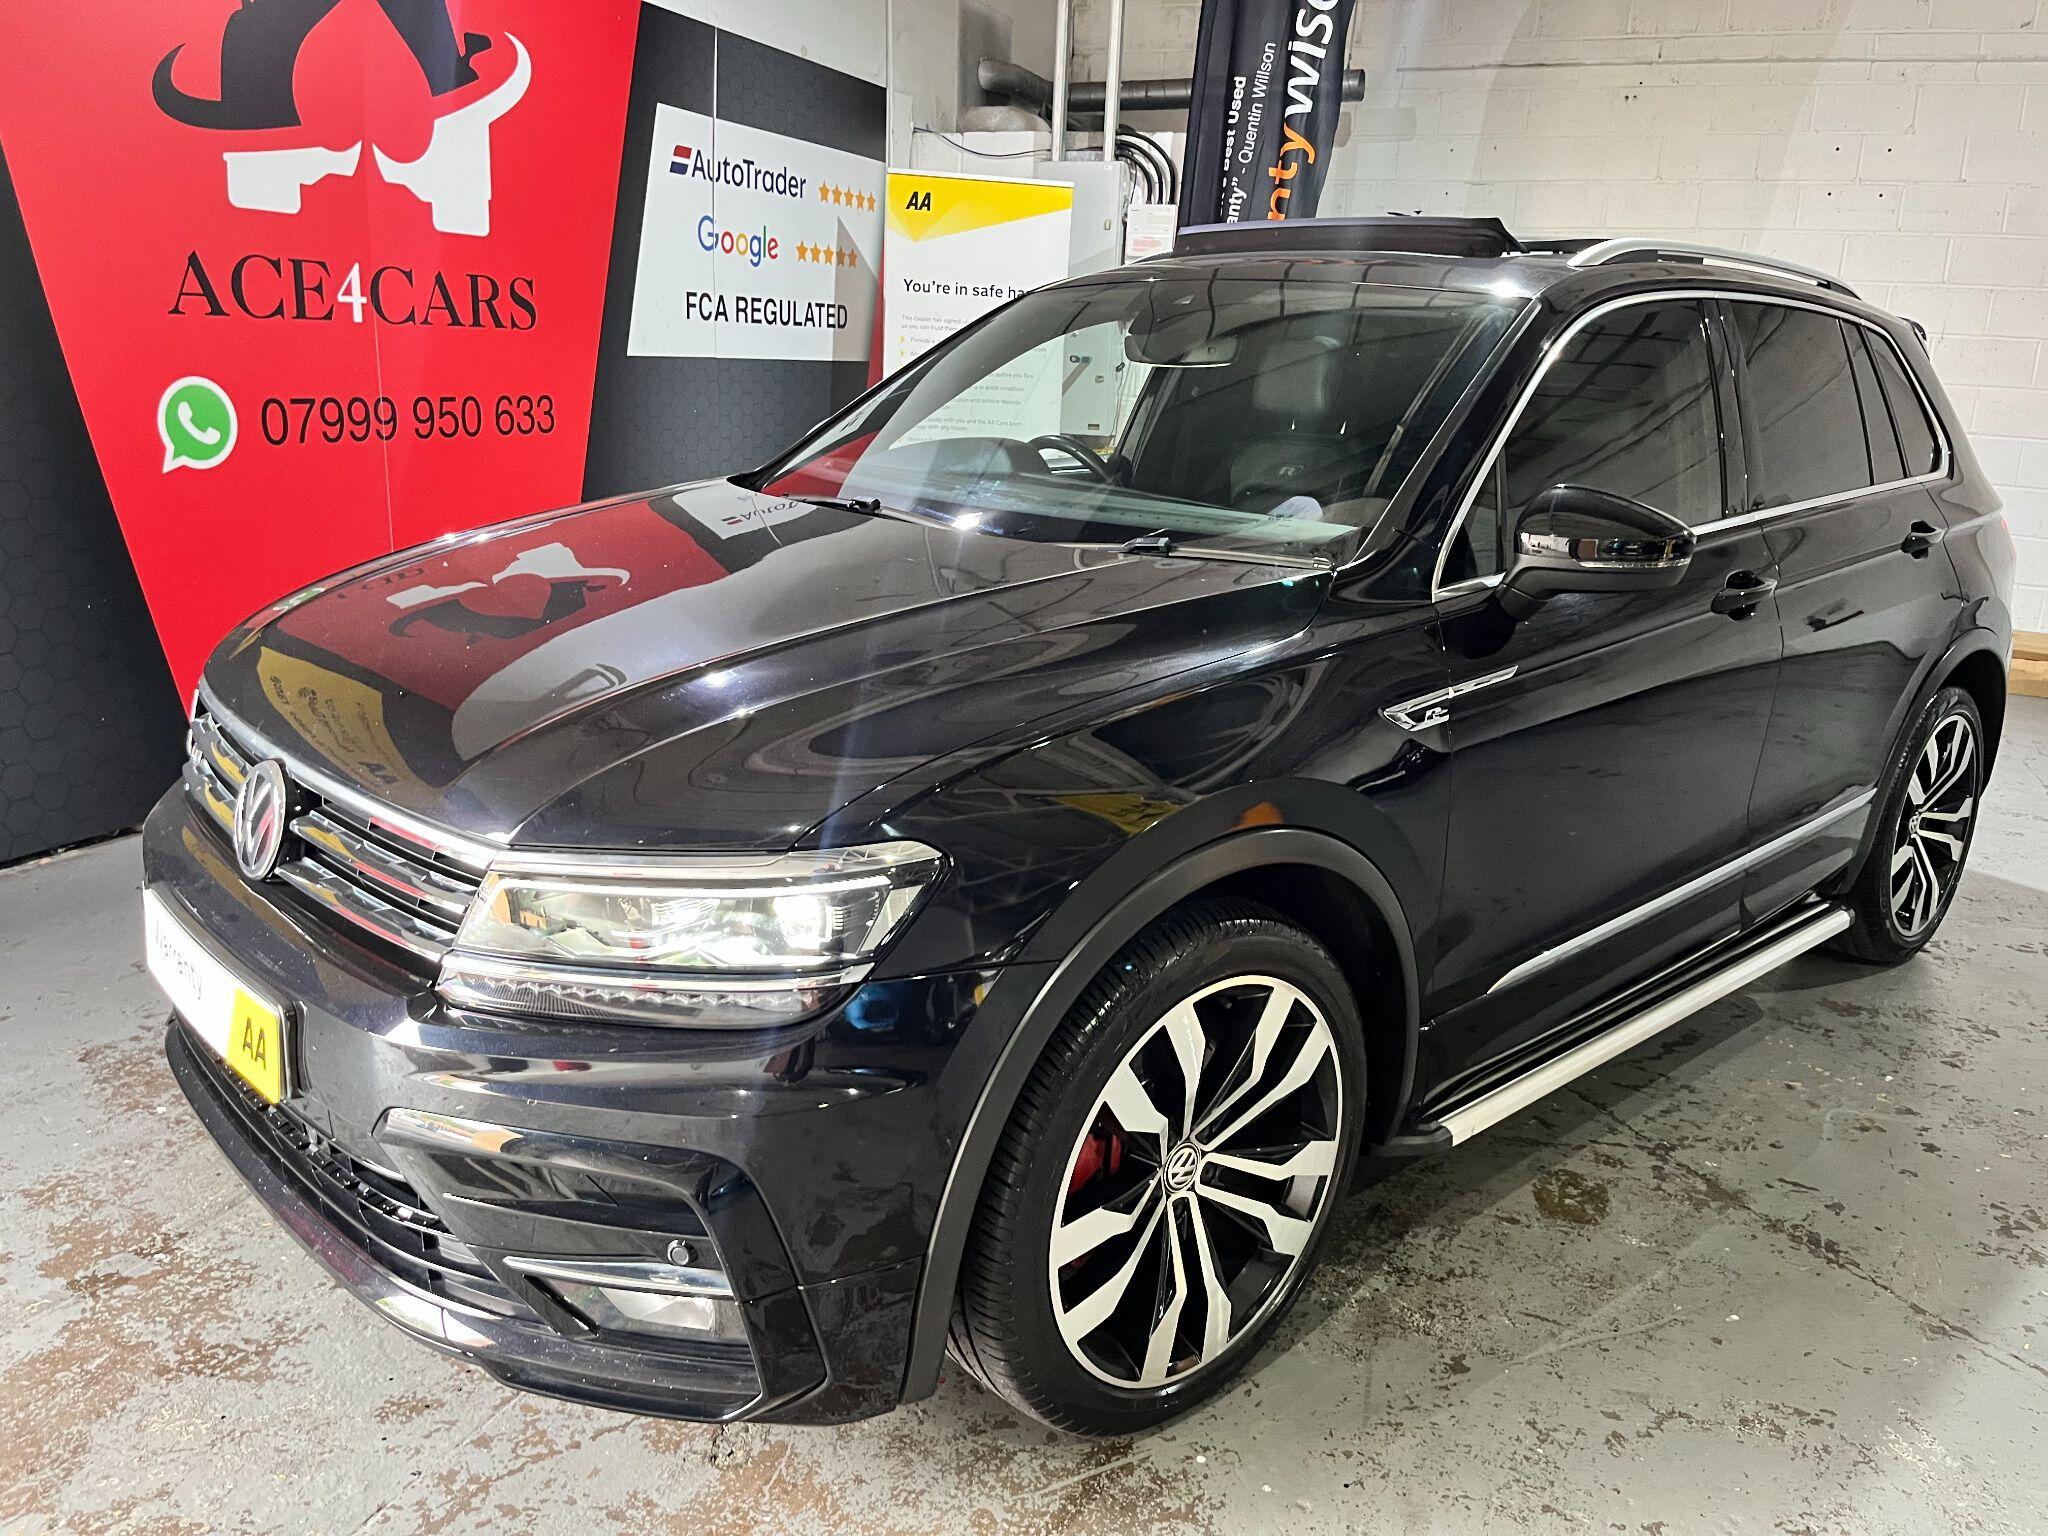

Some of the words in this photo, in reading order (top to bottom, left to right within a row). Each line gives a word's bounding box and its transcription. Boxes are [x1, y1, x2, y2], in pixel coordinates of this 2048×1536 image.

[1227, 76, 1247, 124] Used
[1237, 103, 1264, 165] Quentin
[1251, 42, 1277, 100] Willson
[691, 149, 807, 198] AutoTrader
[906, 191, 932, 211] AA
[697, 215, 779, 267] Google
[168, 250, 537, 330] ACE4CARS
[686, 291, 729, 322] FCA
[736, 297, 848, 329] REGULATED
[903, 278, 951, 295] You're
[955, 282, 968, 296] in
[972, 284, 1004, 298] safe
[1008, 286, 1025, 299] ha
[261, 397, 397, 446] 07999
[412, 396, 482, 439] 950
[494, 394, 556, 436] 633
[242, 1016, 267, 1072] AA
